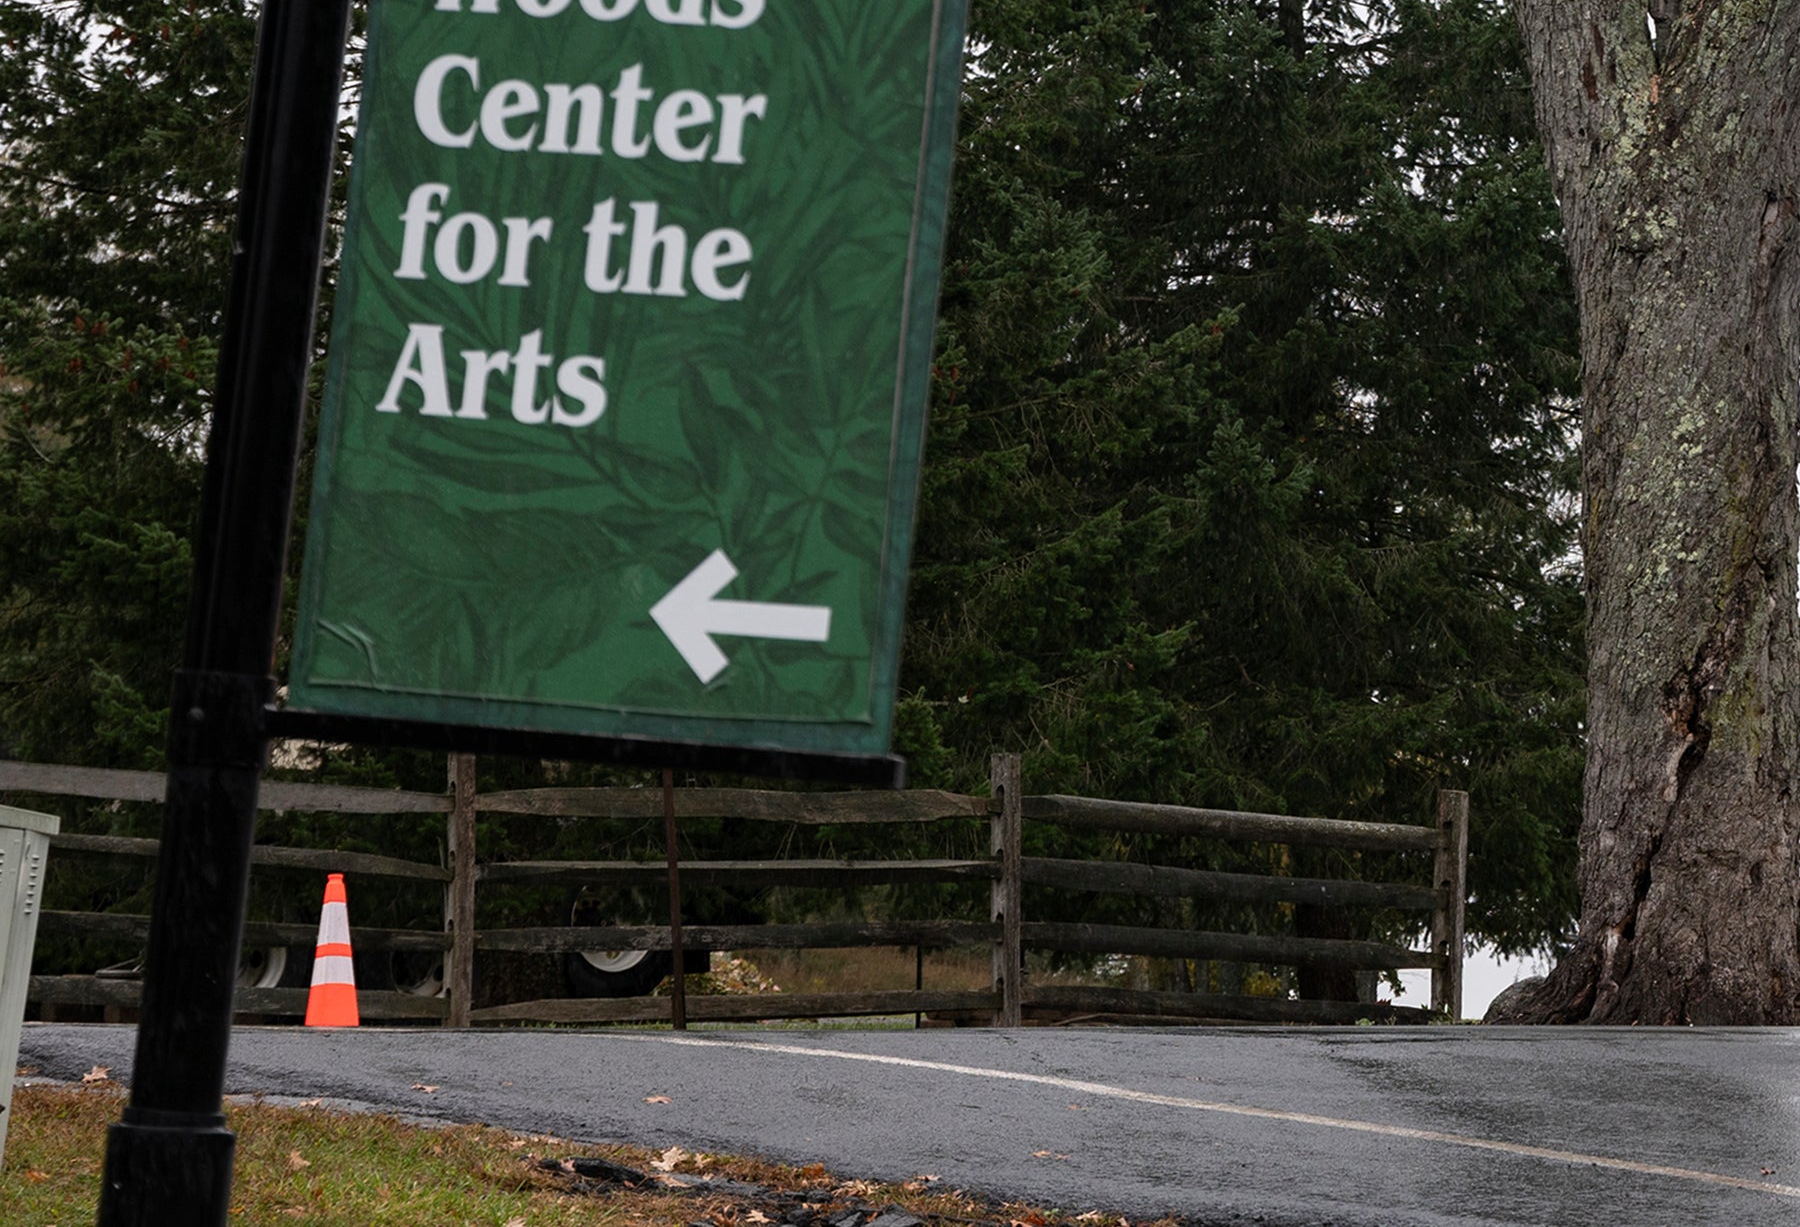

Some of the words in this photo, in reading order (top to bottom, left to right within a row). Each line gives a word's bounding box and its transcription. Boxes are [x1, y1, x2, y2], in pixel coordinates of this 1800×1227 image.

[413, 53, 768, 165] Center
[393, 183, 554, 287] for
[582, 196, 753, 301] the
[375, 323, 608, 427] Arts
